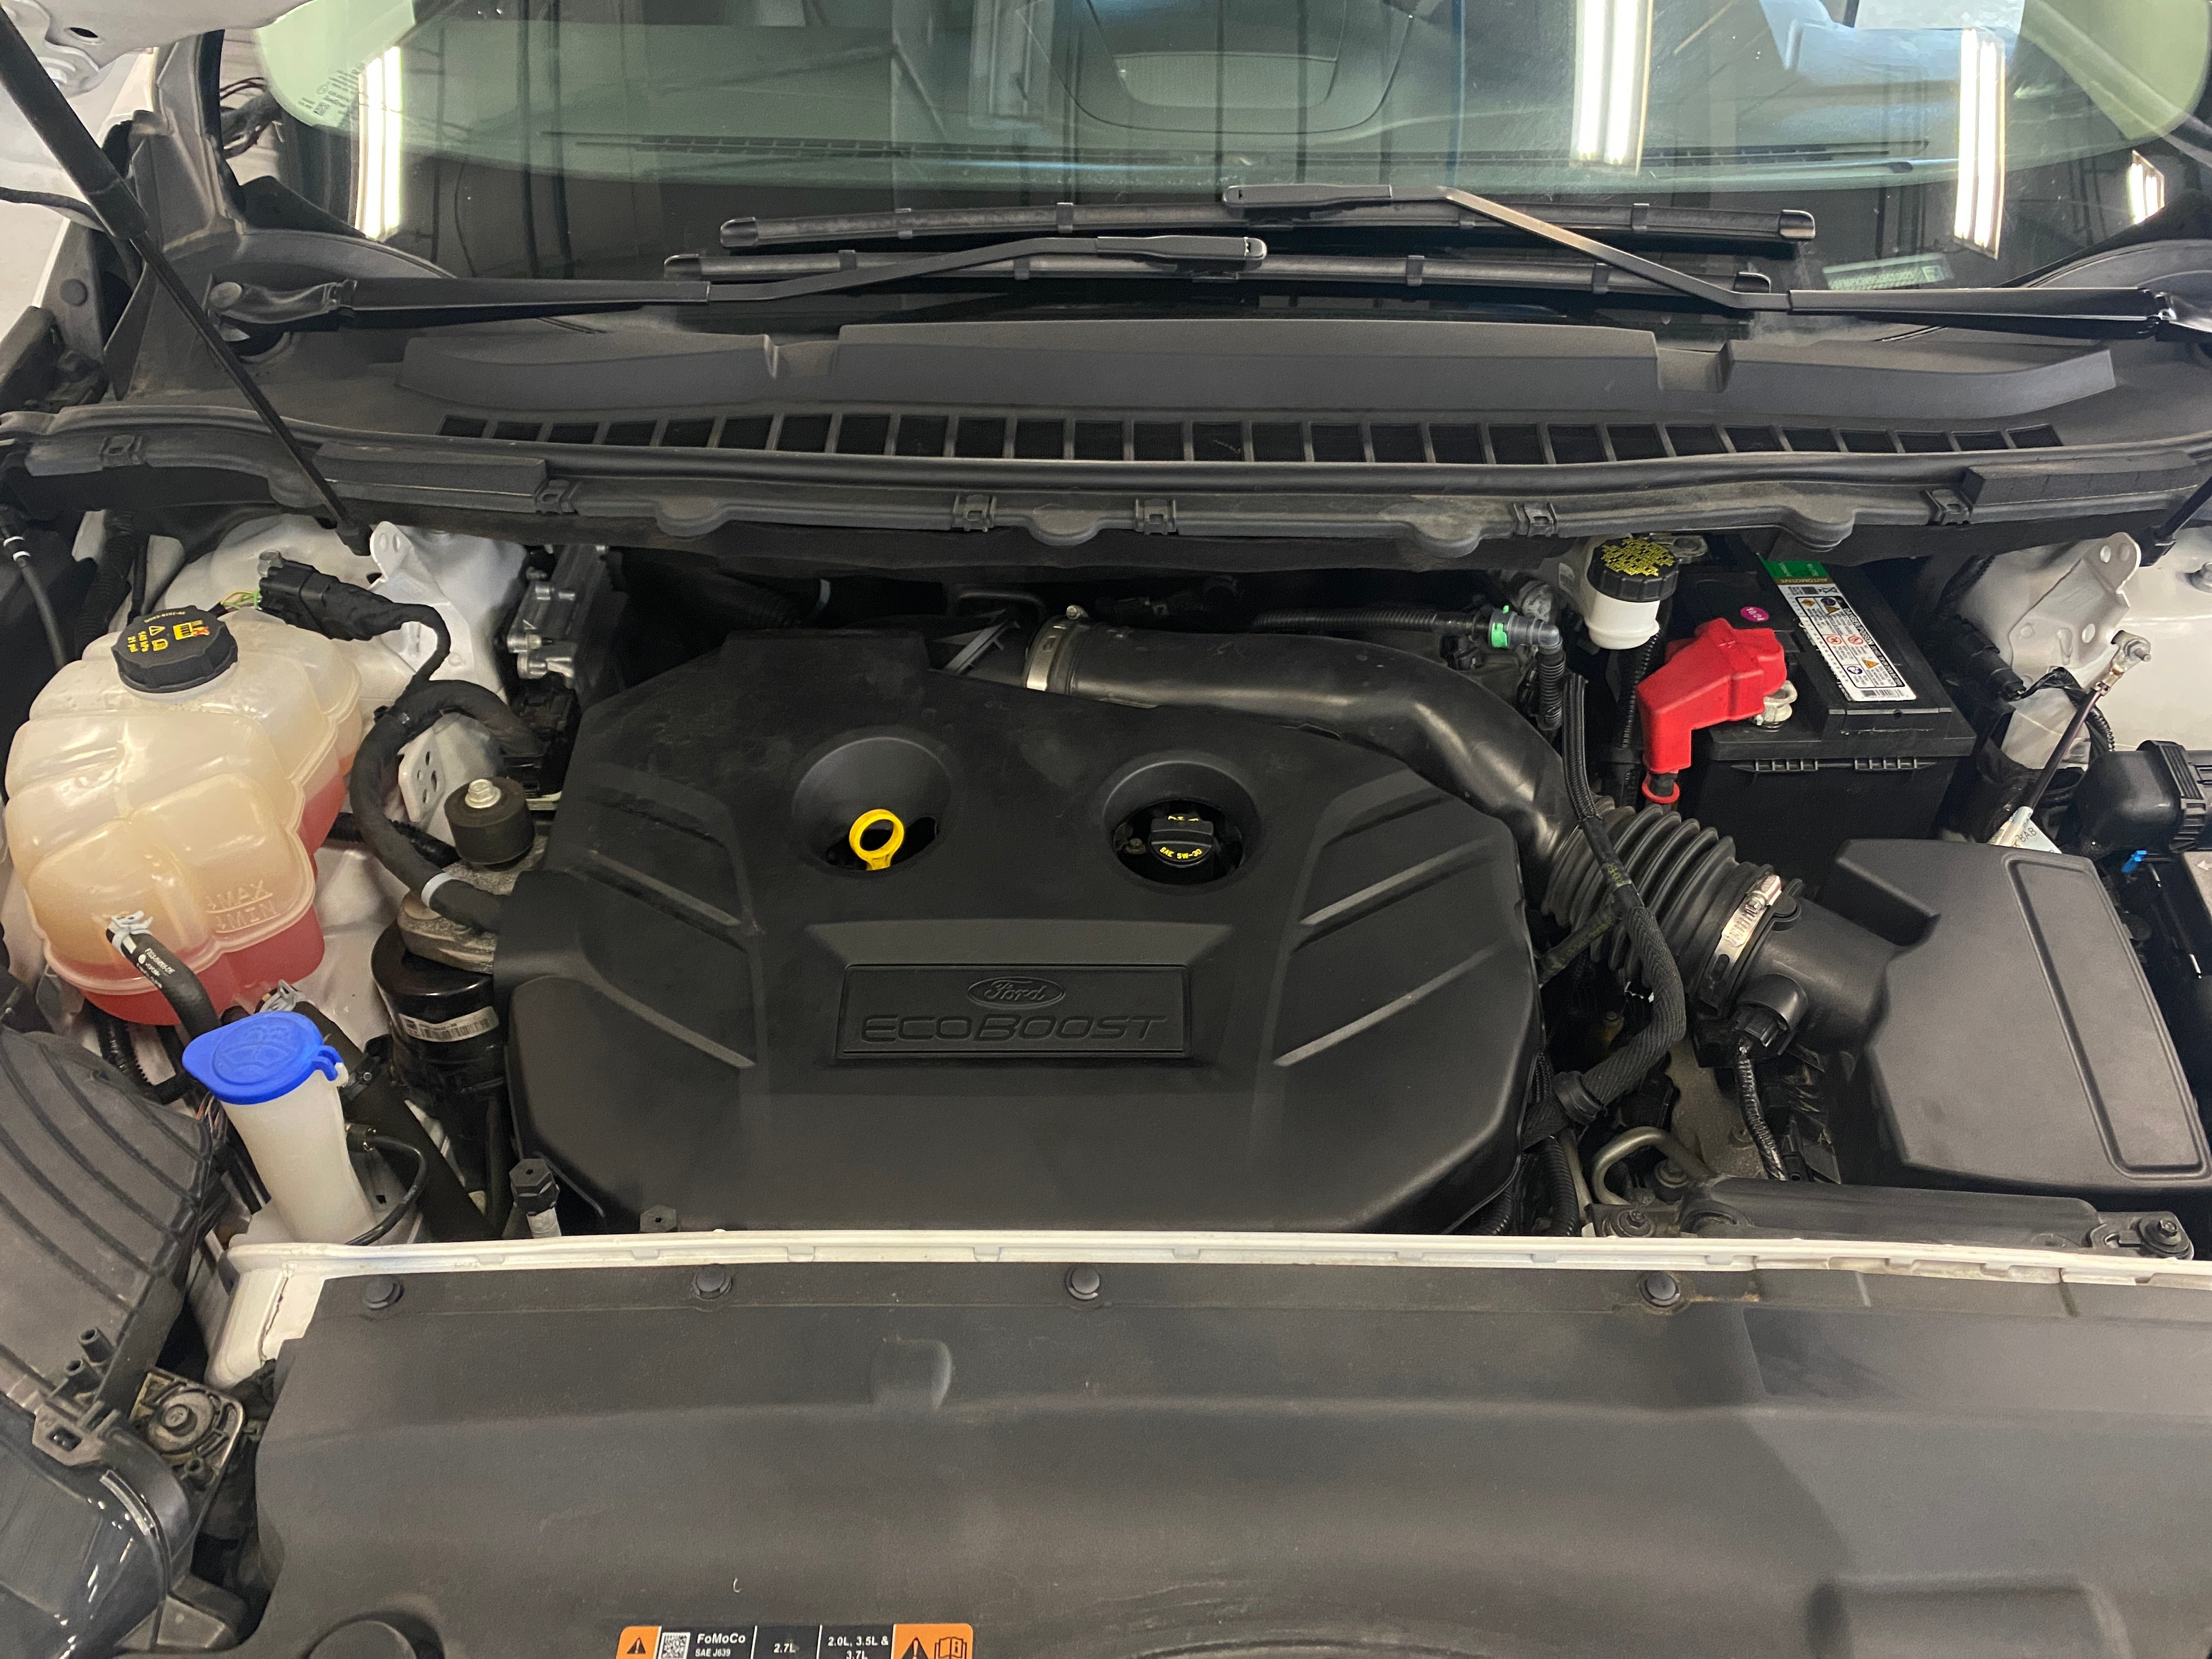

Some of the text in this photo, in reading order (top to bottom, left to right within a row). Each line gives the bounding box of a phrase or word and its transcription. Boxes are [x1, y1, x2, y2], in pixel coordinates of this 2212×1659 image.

[1159, 847, 1202, 859] SAE 5W-30
[218, 879, 269, 909] MAX
[227, 900, 277, 928] MIN
[985, 980, 1047, 1001] Ford
[697, 1633, 746, 1644] FoMoCo
[828, 1637, 889, 1647] 2.0L, 3.5L &
[695, 1648, 731, 1657] SAE J639
[774, 1643, 796, 1653] 2.7L
